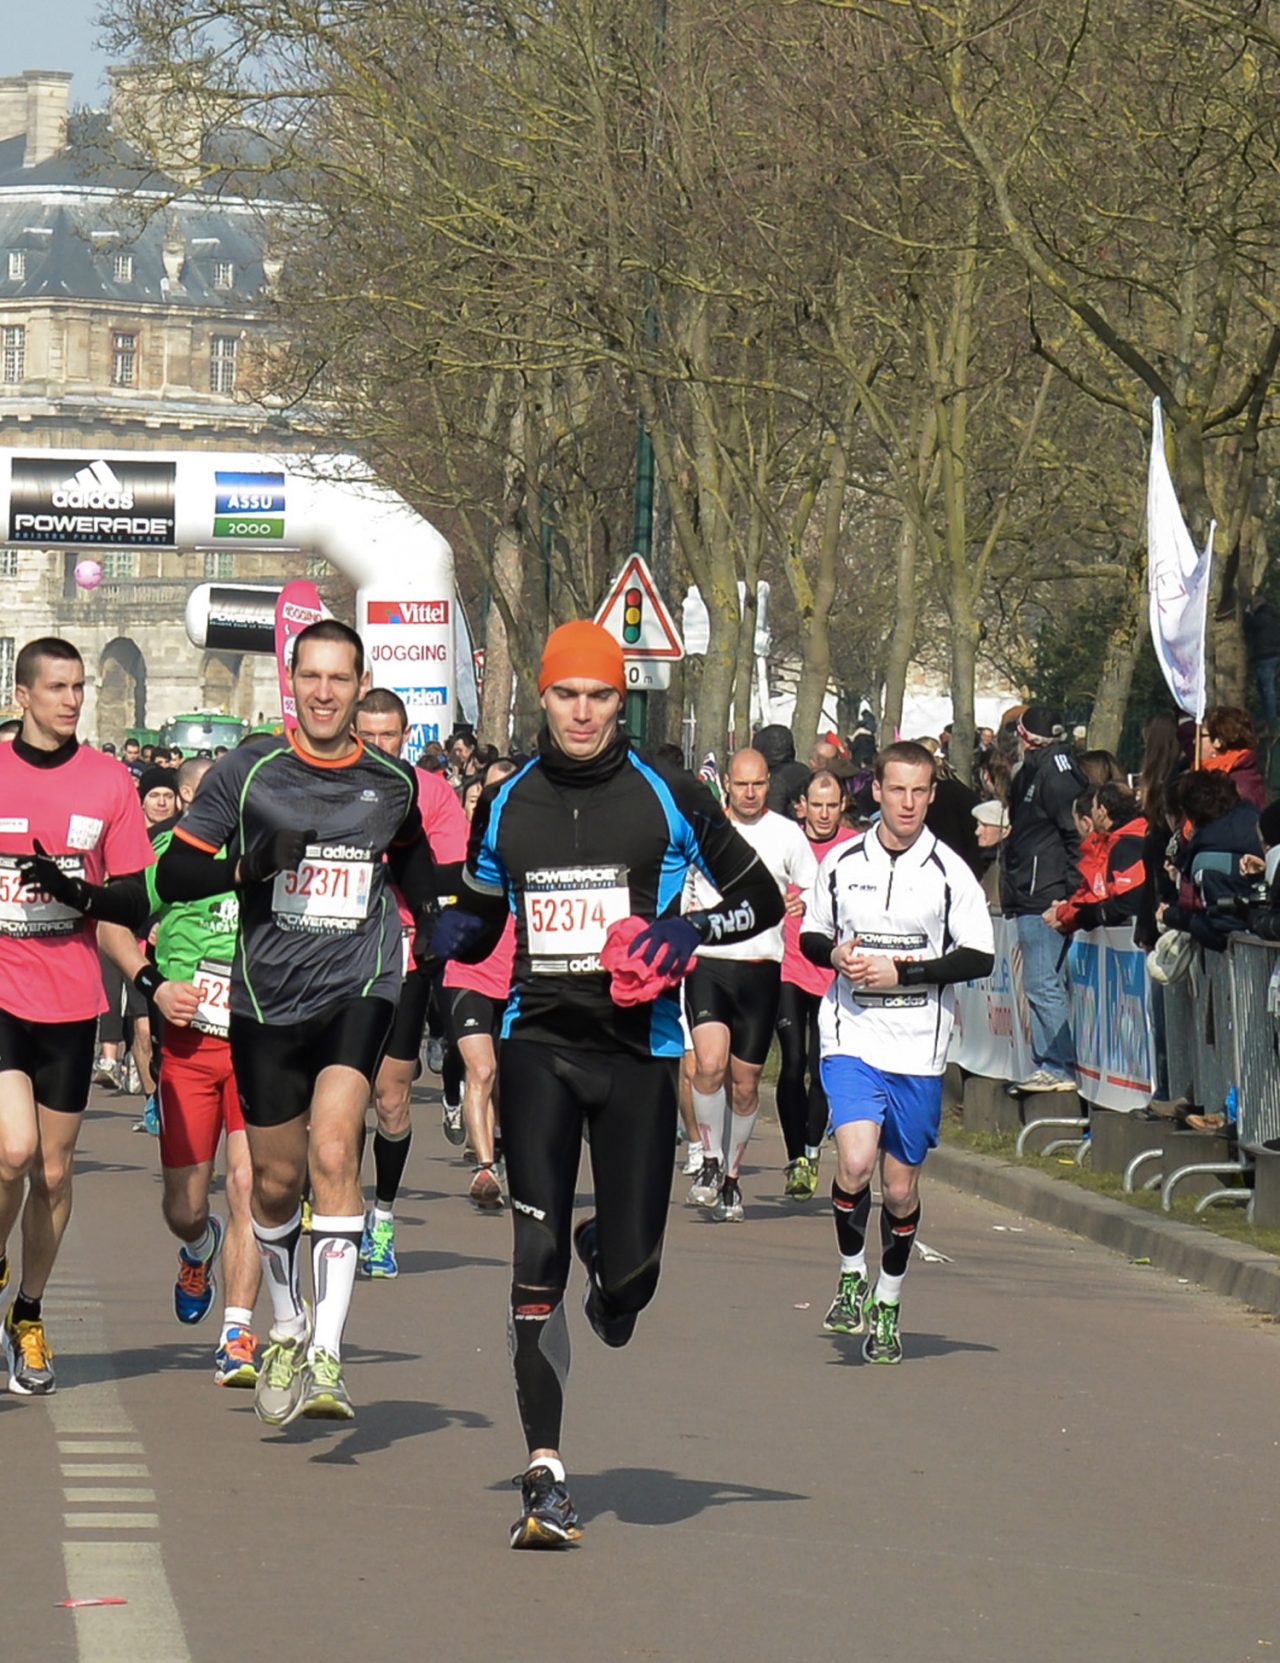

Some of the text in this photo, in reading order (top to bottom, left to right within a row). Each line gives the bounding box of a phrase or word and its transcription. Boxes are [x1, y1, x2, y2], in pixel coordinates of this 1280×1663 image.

[52, 489, 134, 510] adidas
[227, 493, 273, 510] ASSU
[15, 514, 169, 535] POWERADE
[228, 523, 272, 535] 2000
[399, 603, 445, 623] Vittel
[372, 645, 446, 661] JOGGING
[629, 667, 653, 684] 0 m
[322, 845, 370, 860] adidas
[285, 865, 349, 897] 52371
[525, 868, 618, 884] POWERADE
[277, 913, 360, 931] POWERADE
[531, 898, 606, 933] 52374
[190, 1020, 228, 1037] POWE
